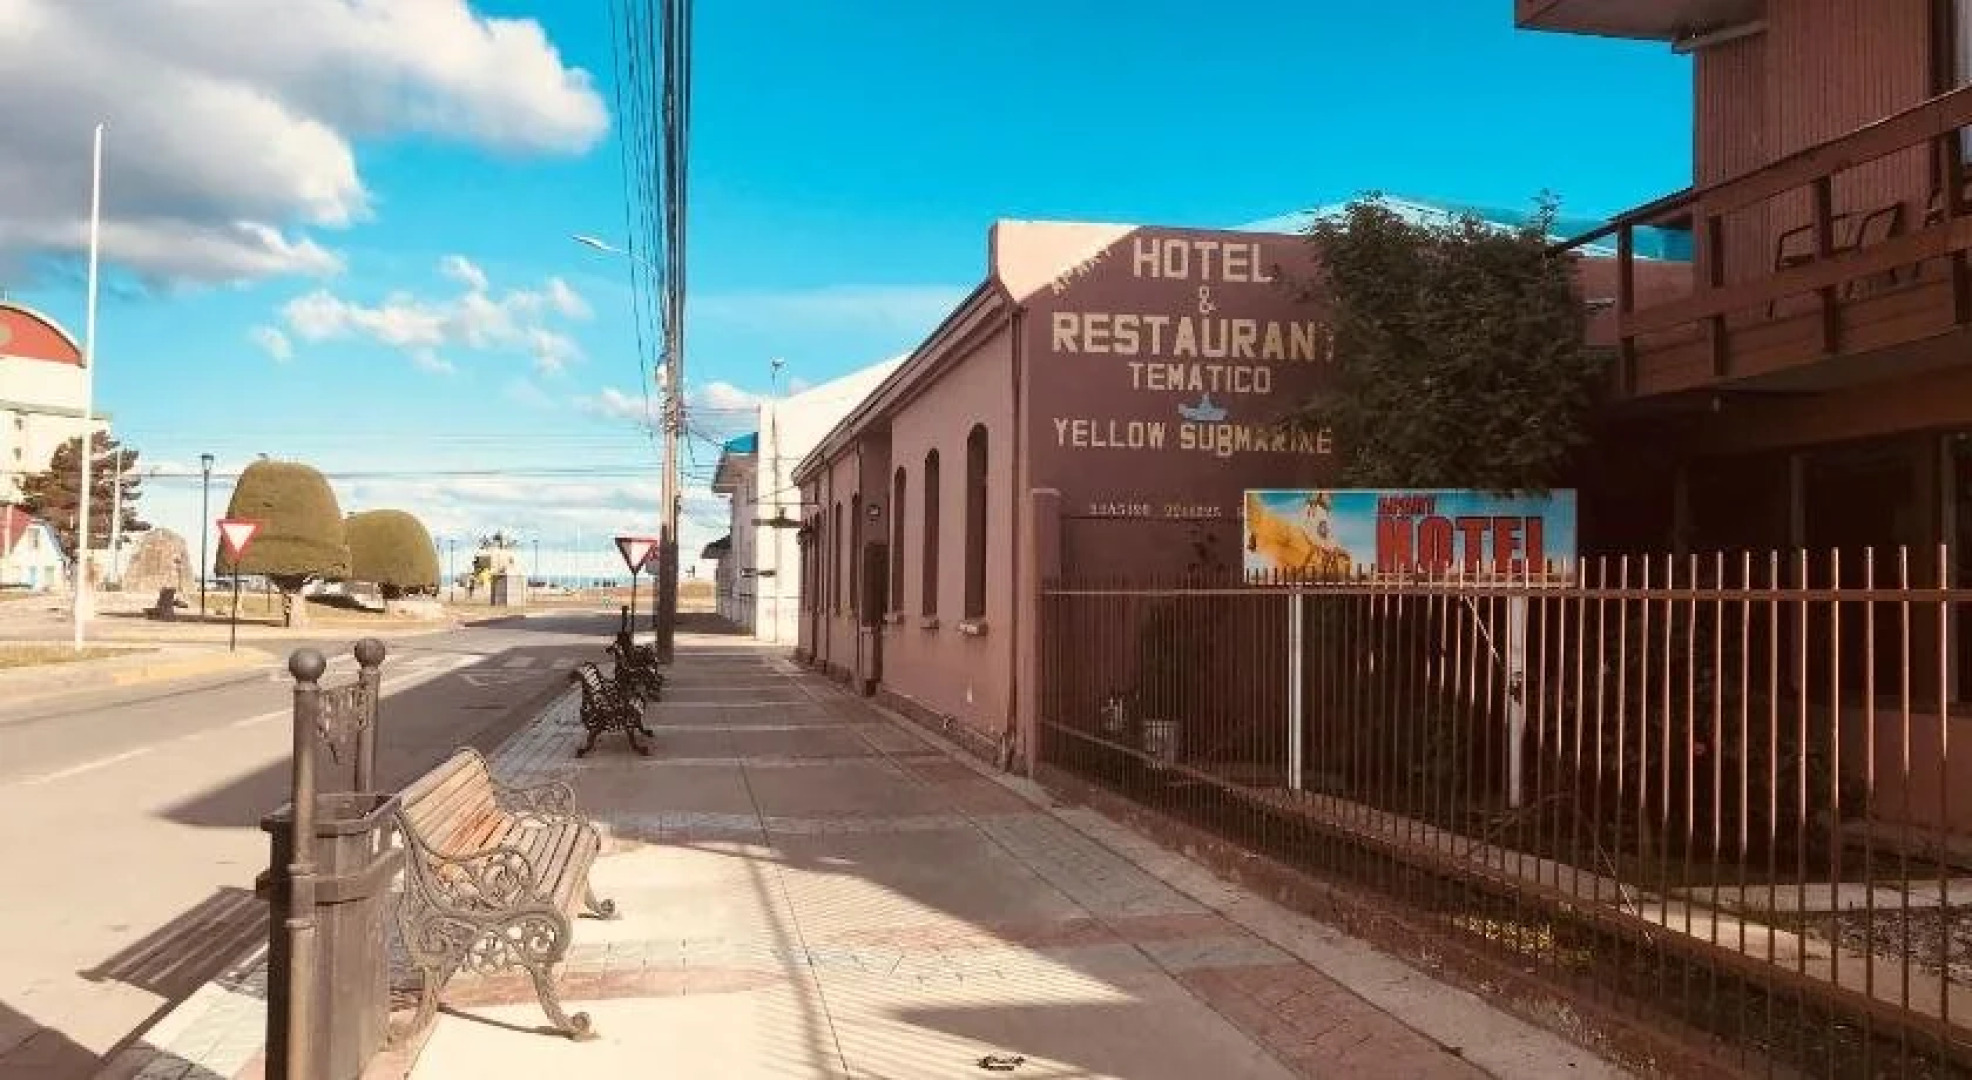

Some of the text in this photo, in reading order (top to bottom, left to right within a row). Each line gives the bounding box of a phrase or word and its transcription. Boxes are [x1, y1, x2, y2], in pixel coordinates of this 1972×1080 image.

[1132, 237, 1274, 283] HOTEL
[1199, 285, 1217, 314] &
[1128, 361, 1272, 393] TEMATICO
[1053, 417, 1166, 450] YELLOW
